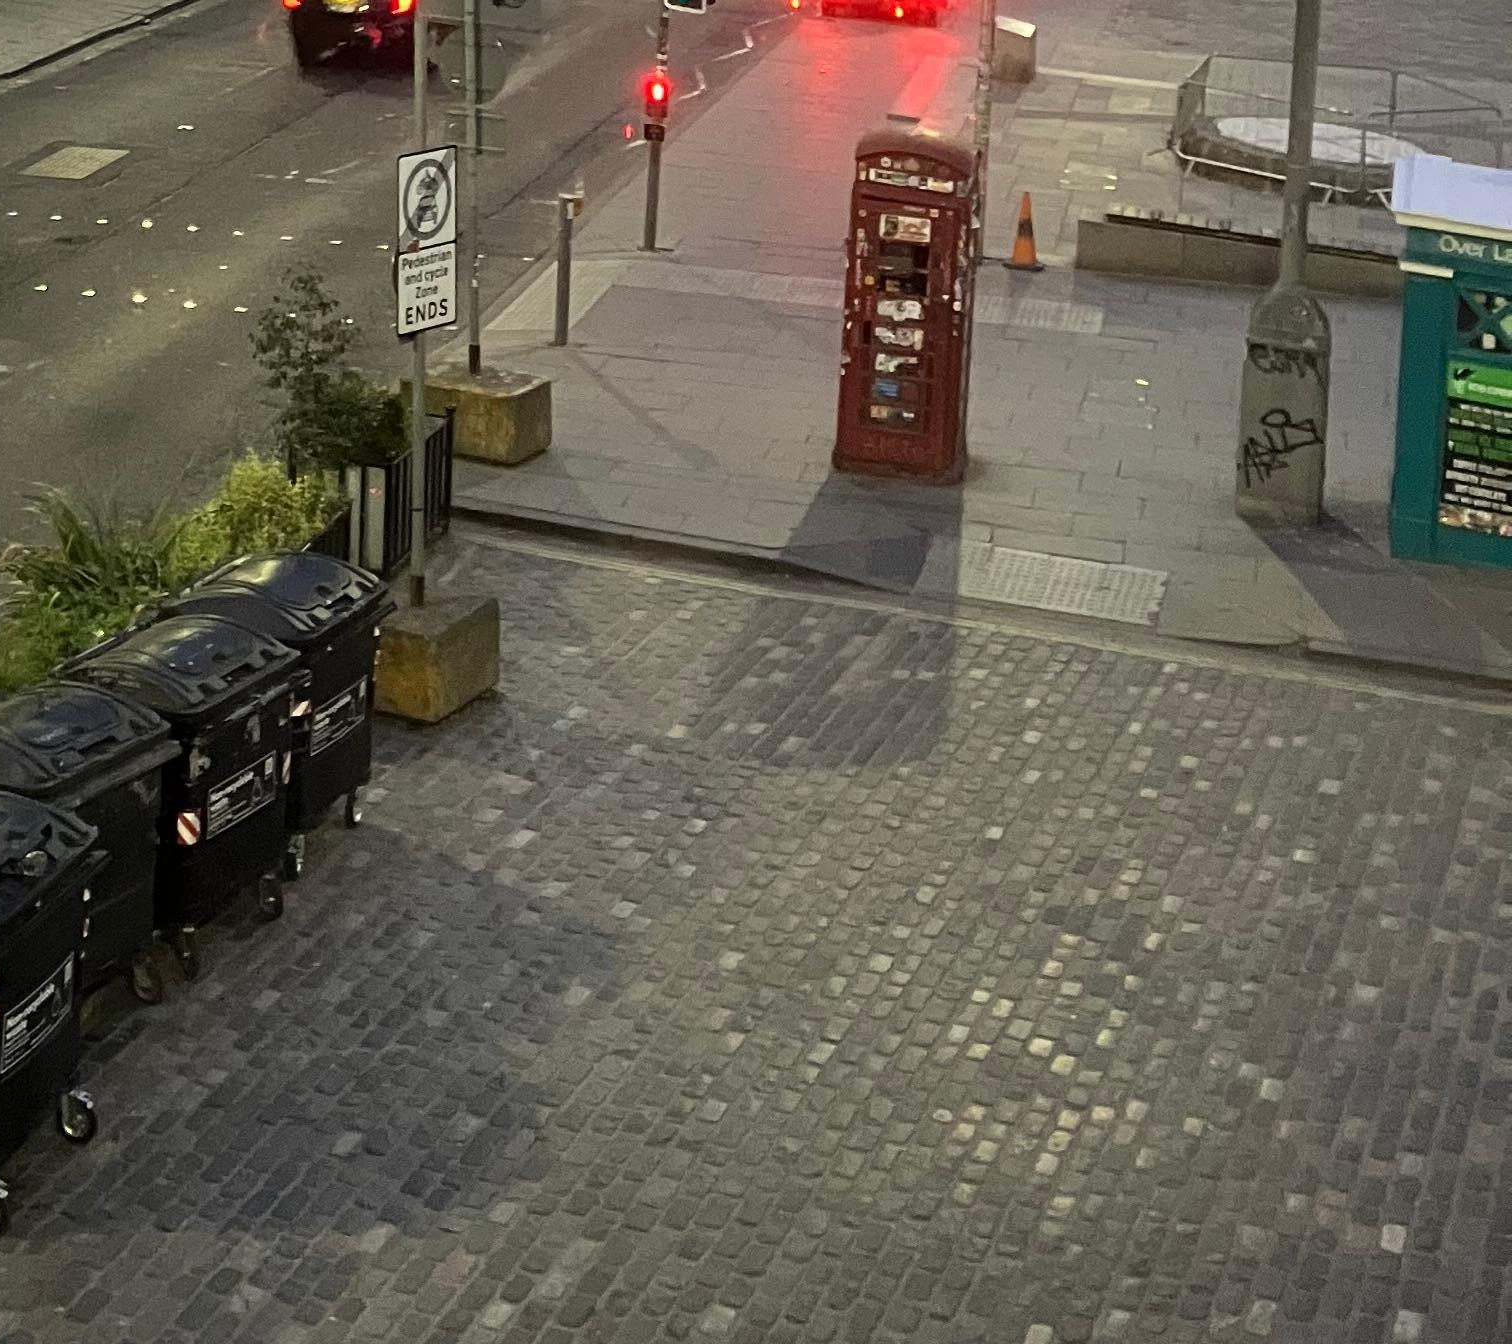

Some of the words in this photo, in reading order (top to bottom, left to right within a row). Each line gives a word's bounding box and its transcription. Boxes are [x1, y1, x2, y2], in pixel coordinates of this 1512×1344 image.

[1439, 234, 1488, 258] Over
[404, 269, 423, 286] and
[415, 284, 439, 300] Zone
[405, 298, 449, 325] ENDS
